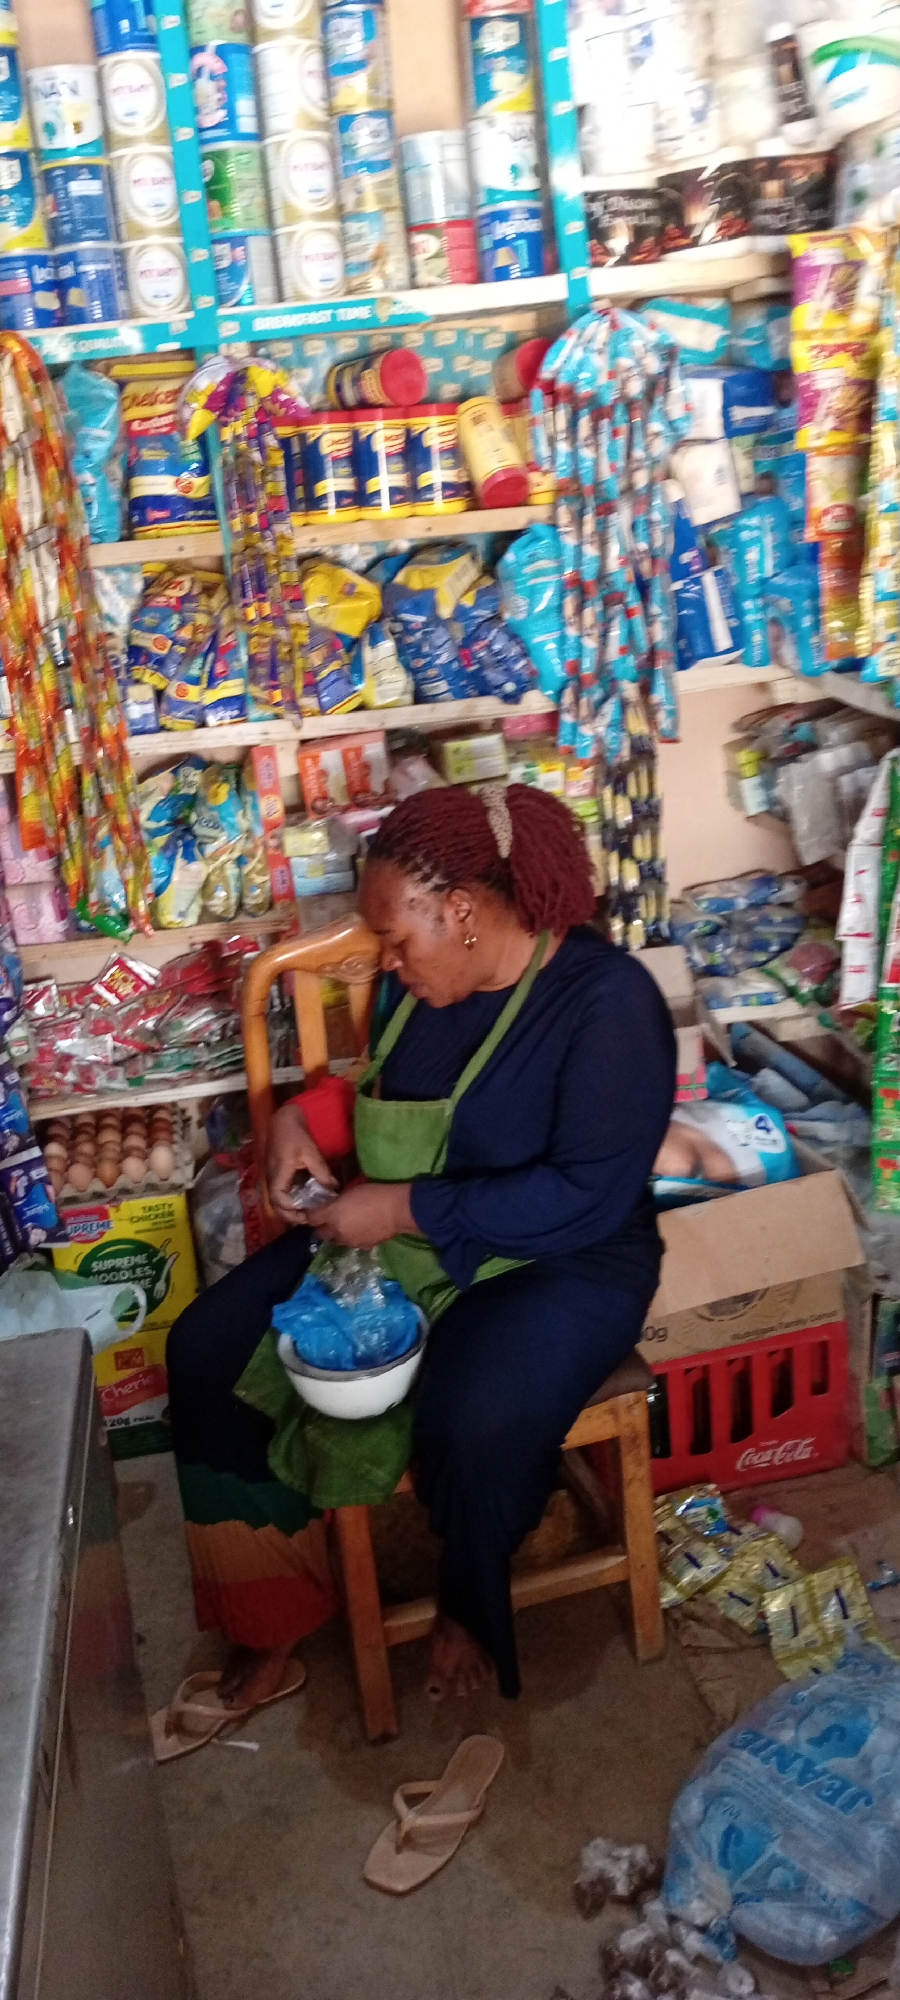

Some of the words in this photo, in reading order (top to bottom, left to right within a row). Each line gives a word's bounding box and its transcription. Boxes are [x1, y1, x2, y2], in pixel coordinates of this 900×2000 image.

[252, 309, 332, 331] BREAKFAST
[335, 305, 373, 321] TIME
[129, 1210, 175, 1224] CHICKEN
[141, 1203, 174, 1214] TASTY
[91, 1253, 149, 1273] SUPREME
[644, 1325, 668, 1343] 0g
[101, 1373, 155, 1400] Cherie
[735, 1436, 817, 1472] Coca-Cola
[728, 1728, 875, 1814] JEANIE
